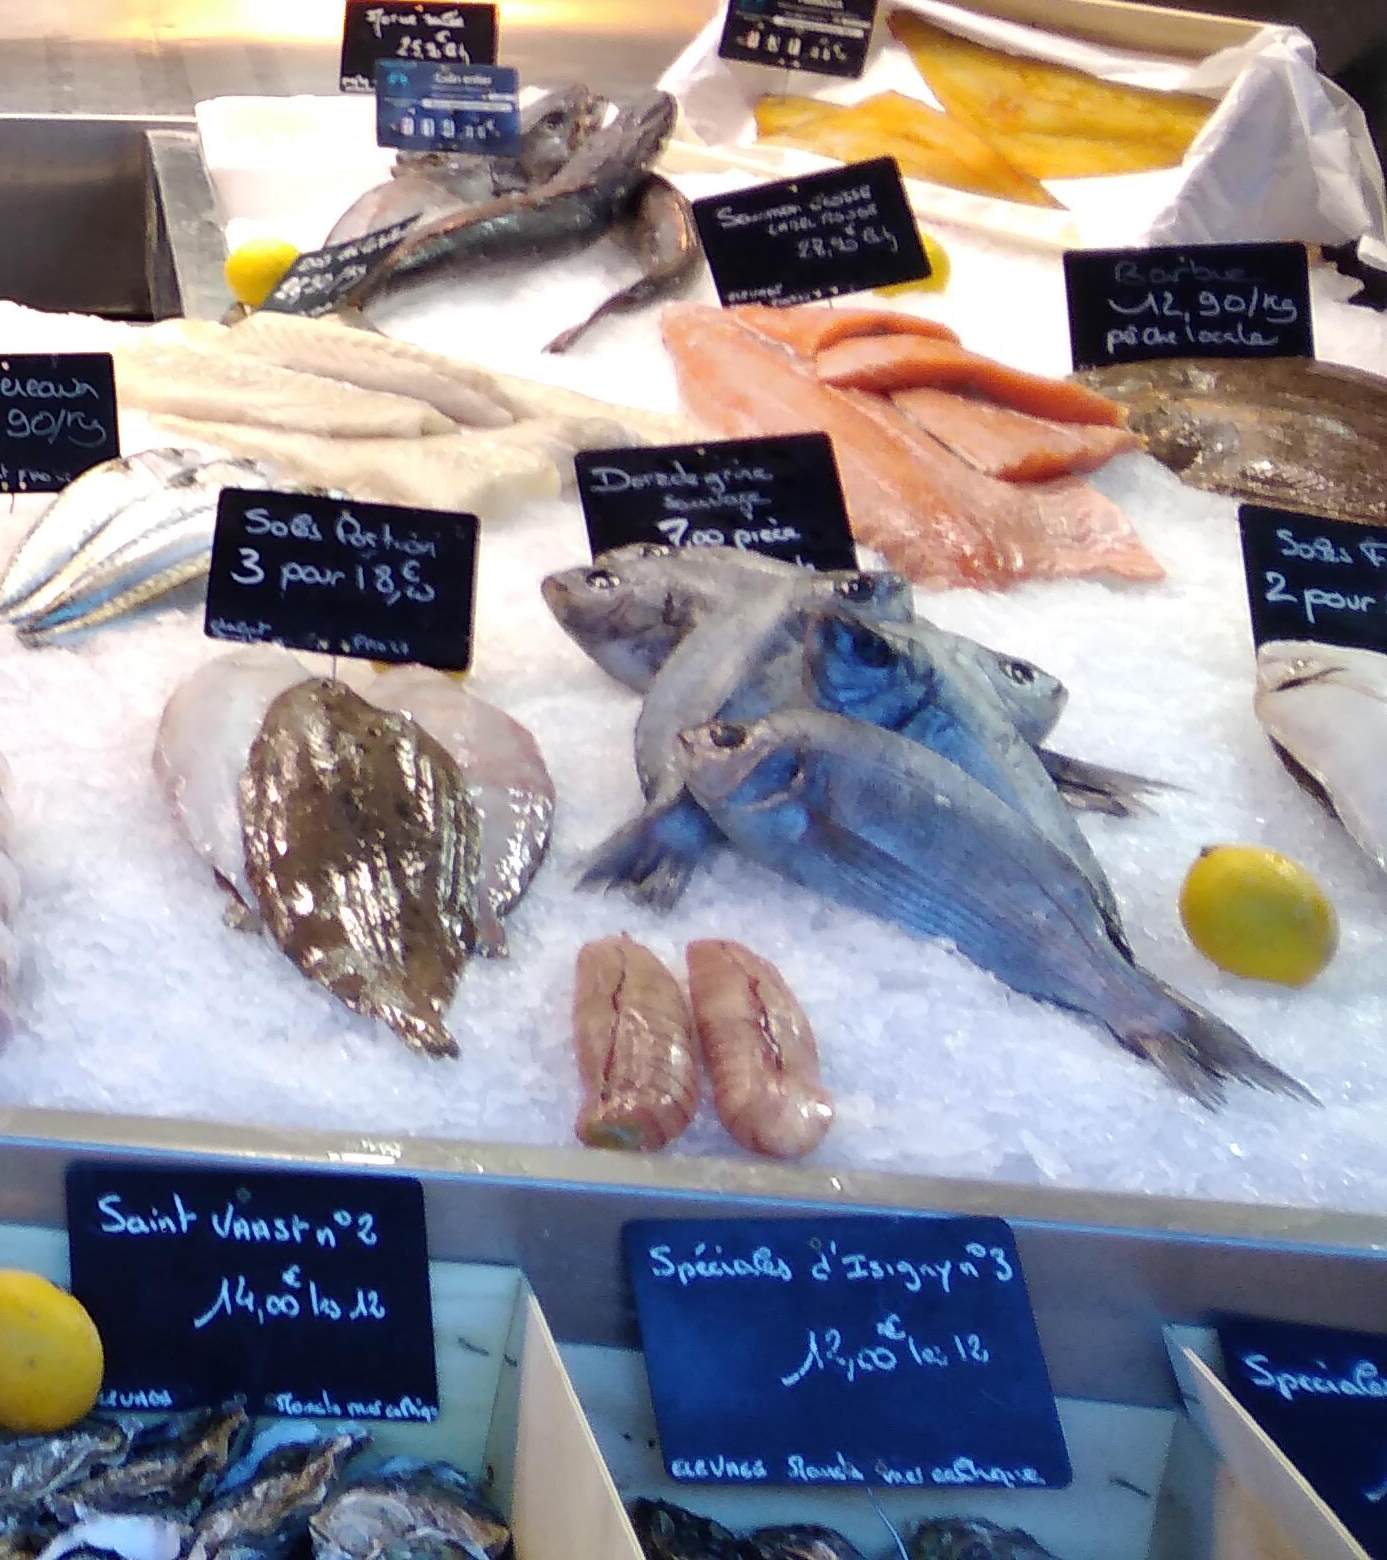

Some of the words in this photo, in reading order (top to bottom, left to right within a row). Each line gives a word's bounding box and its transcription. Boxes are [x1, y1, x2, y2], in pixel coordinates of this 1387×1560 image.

[228, 546, 266, 586] 3
[279, 560, 347, 593] pour
[1264, 570, 1299, 604] 2
[1302, 587, 1378, 625] pour
[96, 1191, 198, 1236] Saint
[307, 1278, 342, 1321] les
[348, 1286, 386, 1321] 12
[907, 1333, 949, 1368] les
[953, 1332, 991, 1366] 12
